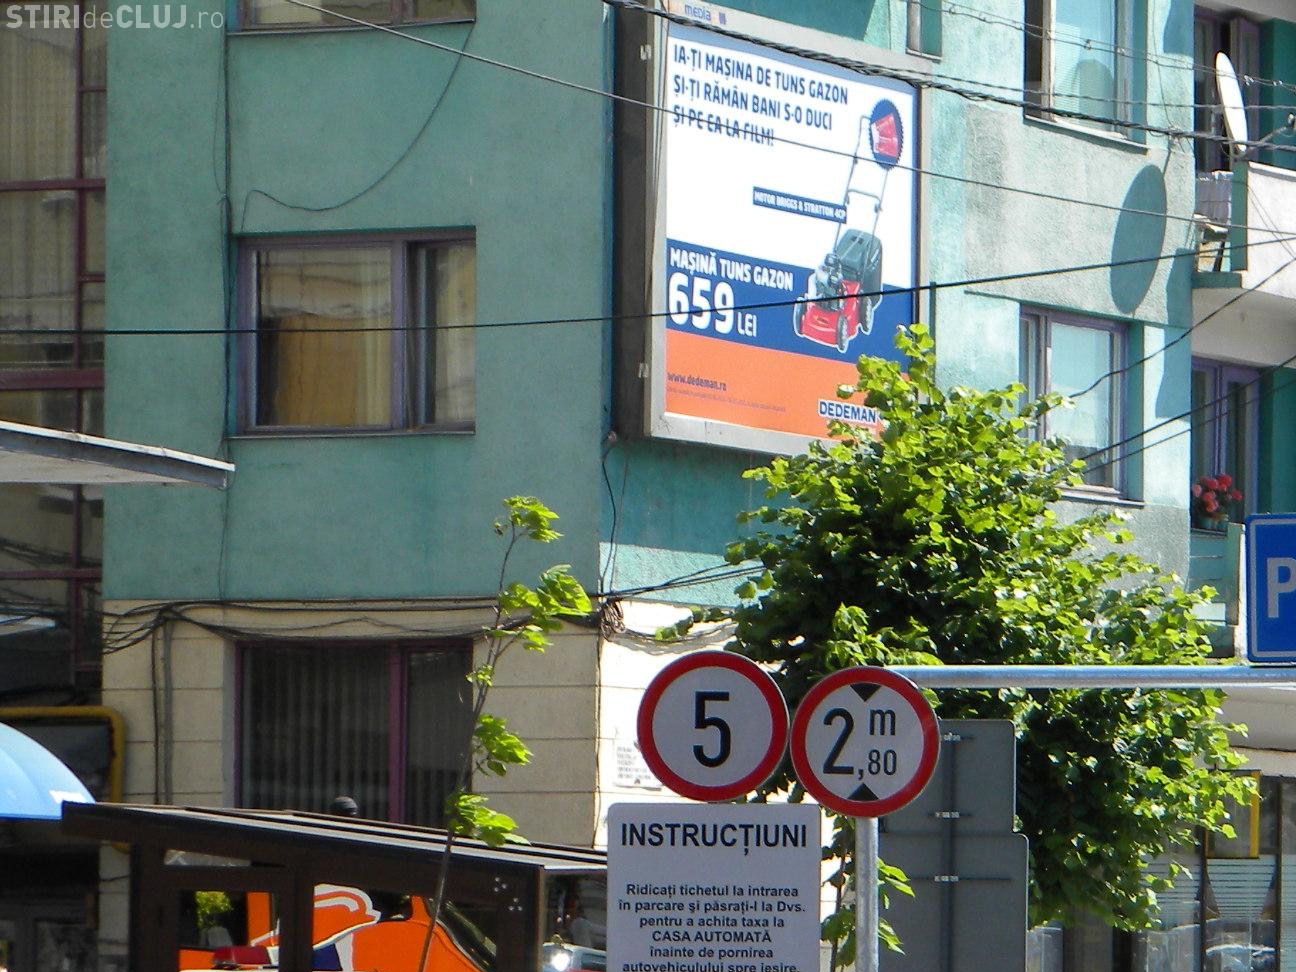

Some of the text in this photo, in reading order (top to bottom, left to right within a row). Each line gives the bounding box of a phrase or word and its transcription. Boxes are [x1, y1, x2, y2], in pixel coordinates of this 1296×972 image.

[756, 65, 771, 87] DE
[774, 70, 805, 95] TUNS
[809, 80, 848, 105] GAZON
[688, 108, 703, 130] PE
[726, 118, 740, 139] LA
[752, 94, 780, 119] BANI
[806, 107, 832, 130] DUCI
[719, 258, 752, 283] TUNS
[753, 266, 793, 291] GAZON
[668, 272, 757, 337] 659 LEI
[819, 401, 876, 423] DEDEMAN
[693, 690, 731, 768] 5
[621, 823, 807, 856] INSTRUCȚIUNI
[680, 884, 729, 896] tichetul
[733, 885, 744, 896] la
[748, 885, 798, 897] intrarea
[635, 902, 684, 913] parcare
[761, 901, 773, 912] la
[777, 901, 806, 912] Dvs.
[639, 916, 785, 929] pentru a achita taxa la
[652, 929, 772, 943] CASA AUTOMATĂ
[650, 947, 773, 960] înainte de pornirea
[622, 962, 724, 972] autovehiculului
